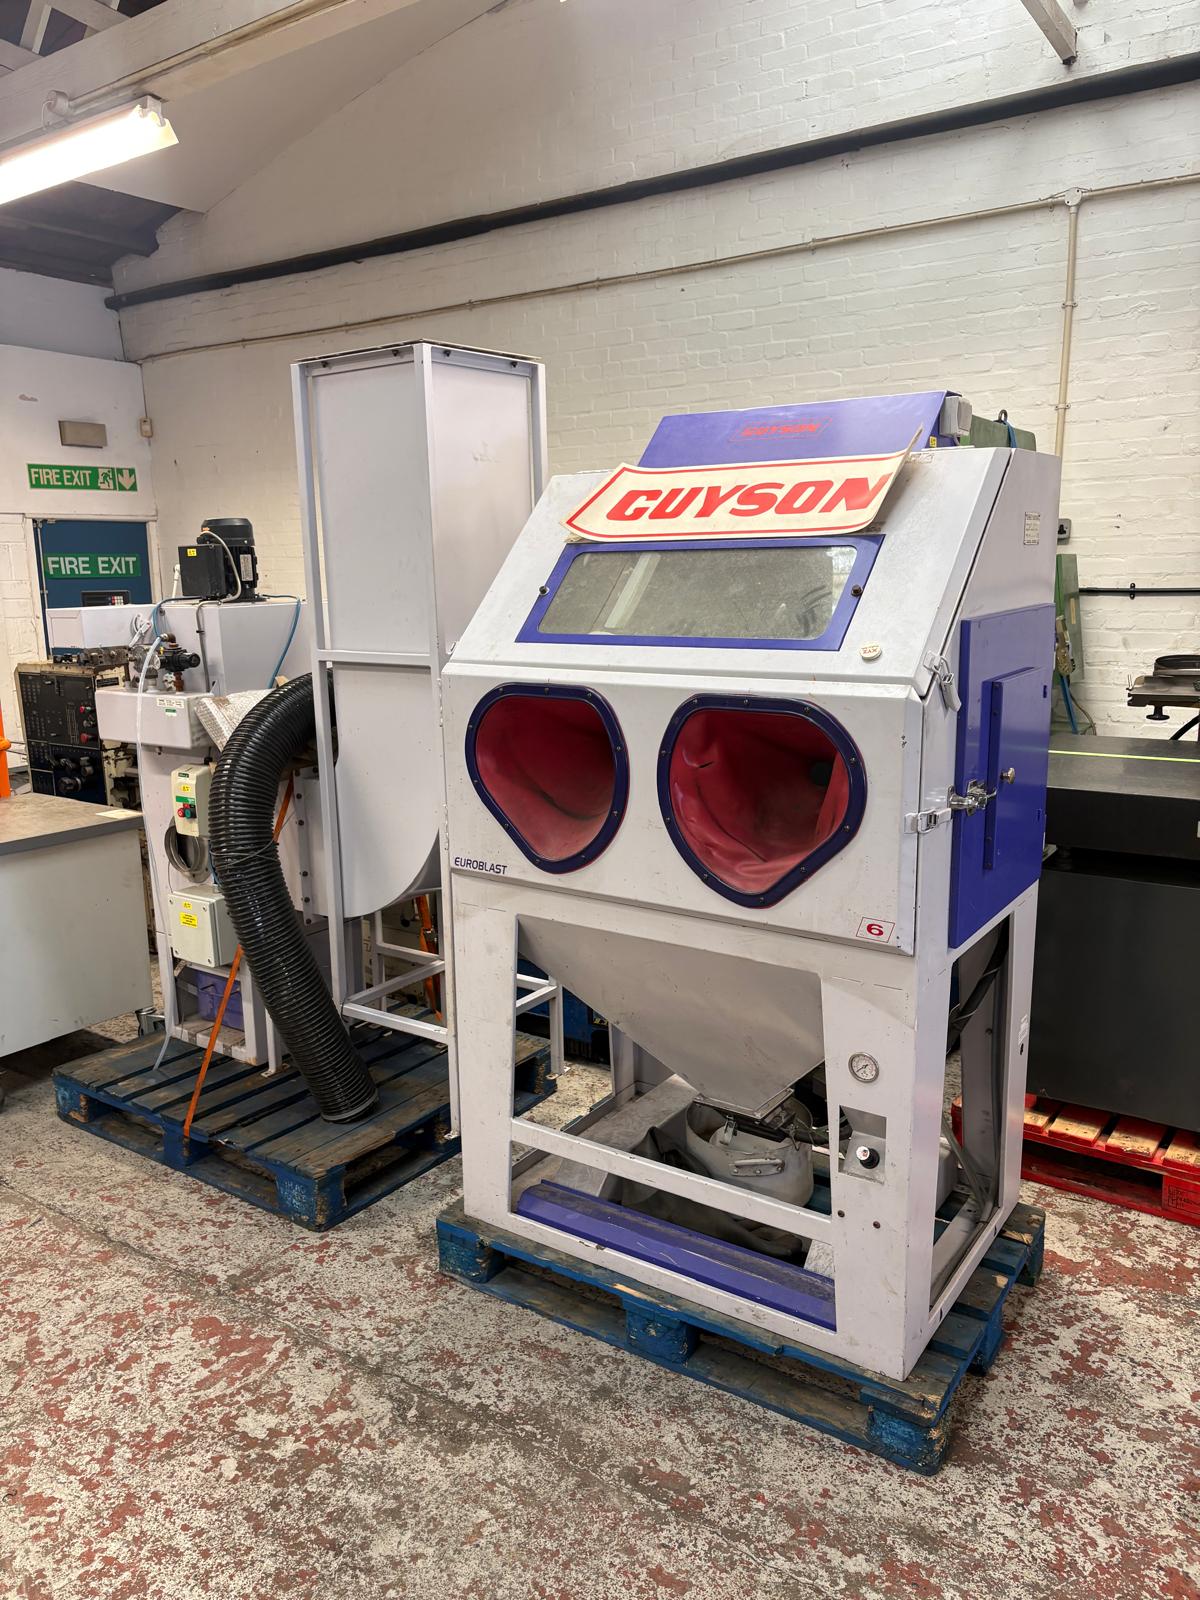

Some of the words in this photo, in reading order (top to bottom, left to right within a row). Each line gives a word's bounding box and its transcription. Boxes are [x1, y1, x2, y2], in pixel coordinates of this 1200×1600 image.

[30, 468, 62, 486] FIRE
[63, 468, 92, 487] EXIT
[606, 471, 894, 522] GUYSON
[47, 556, 92, 575] FIRE
[97, 556, 137, 575] EXIT
[454, 856, 508, 875] EUROBLAST
[866, 923, 884, 936] 6
